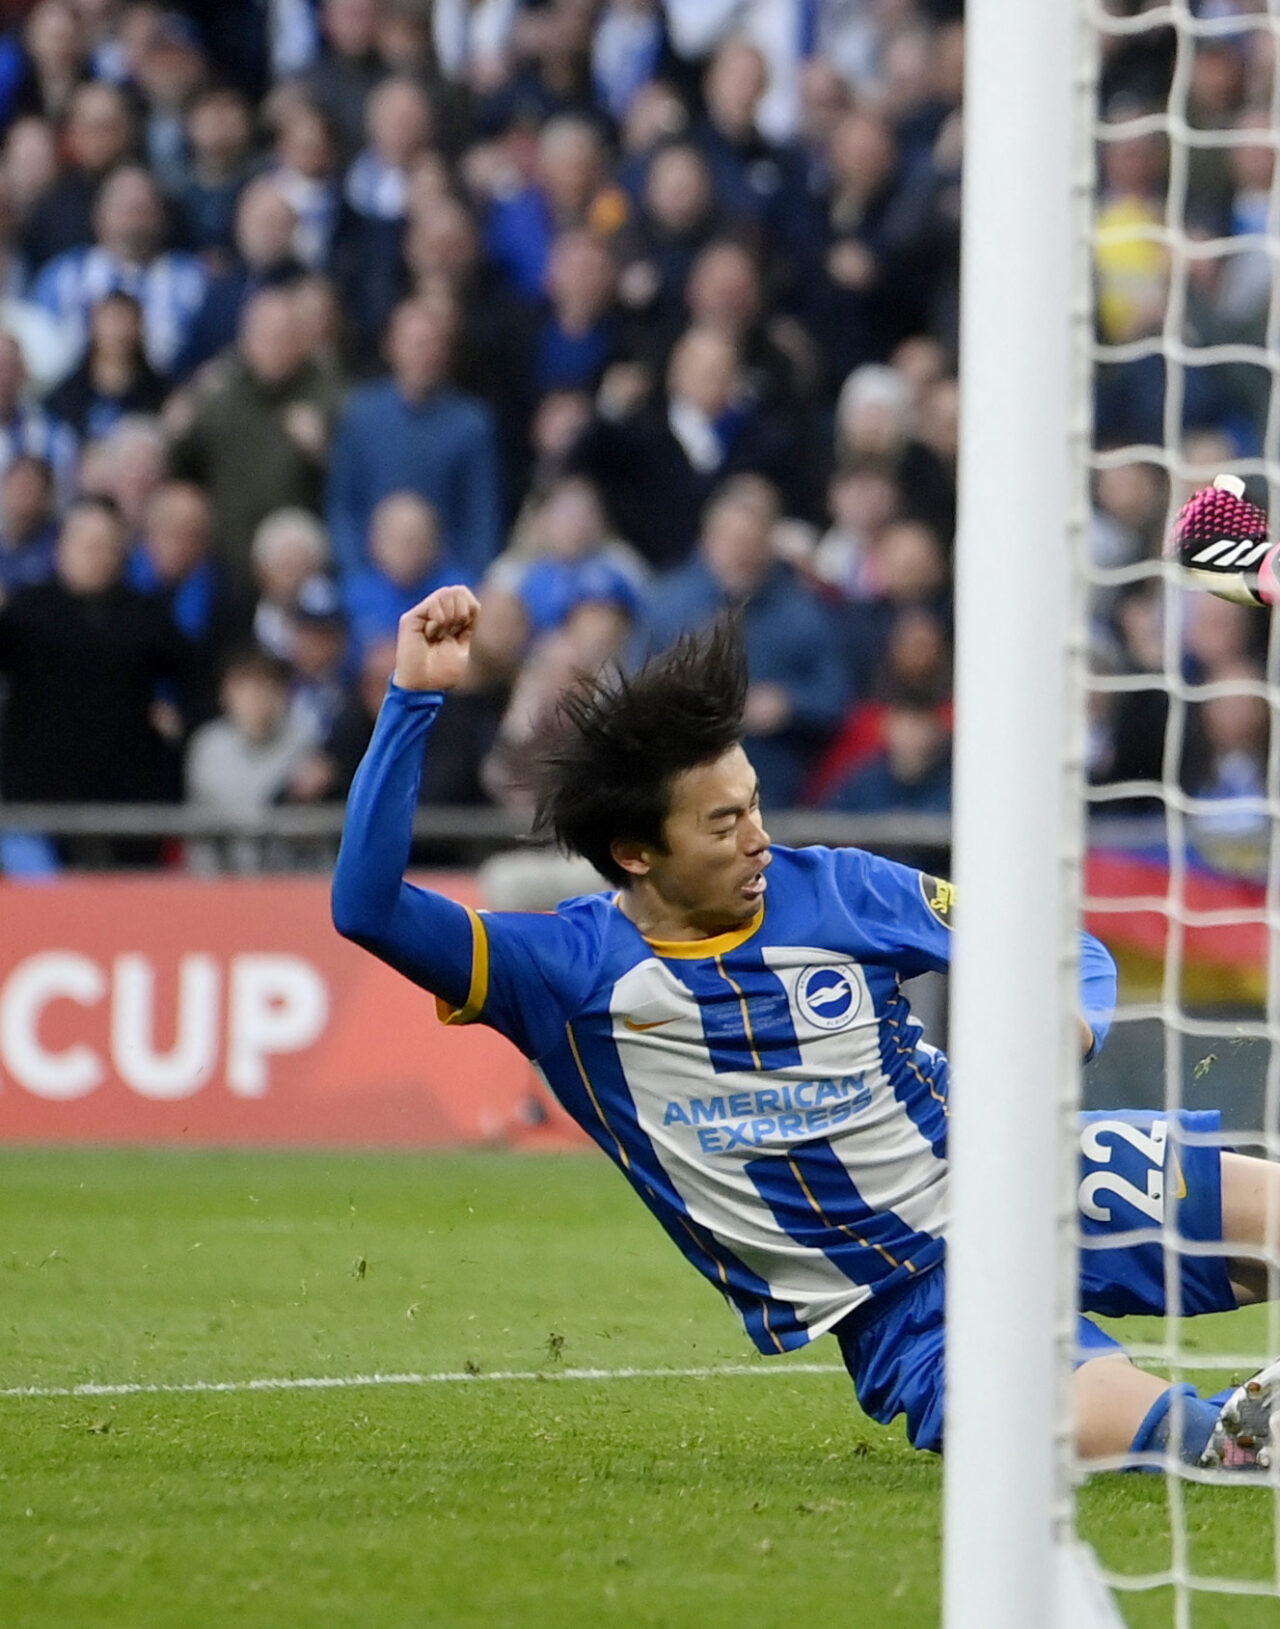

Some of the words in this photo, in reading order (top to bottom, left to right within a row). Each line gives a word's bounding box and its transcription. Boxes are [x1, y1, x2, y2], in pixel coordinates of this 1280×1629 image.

[0, 950, 329, 1099] CUP
[663, 1070, 866, 1126] AMERICAN
[698, 1087, 873, 1153] EXPRESS
[1079, 1120, 1168, 1224] 22
